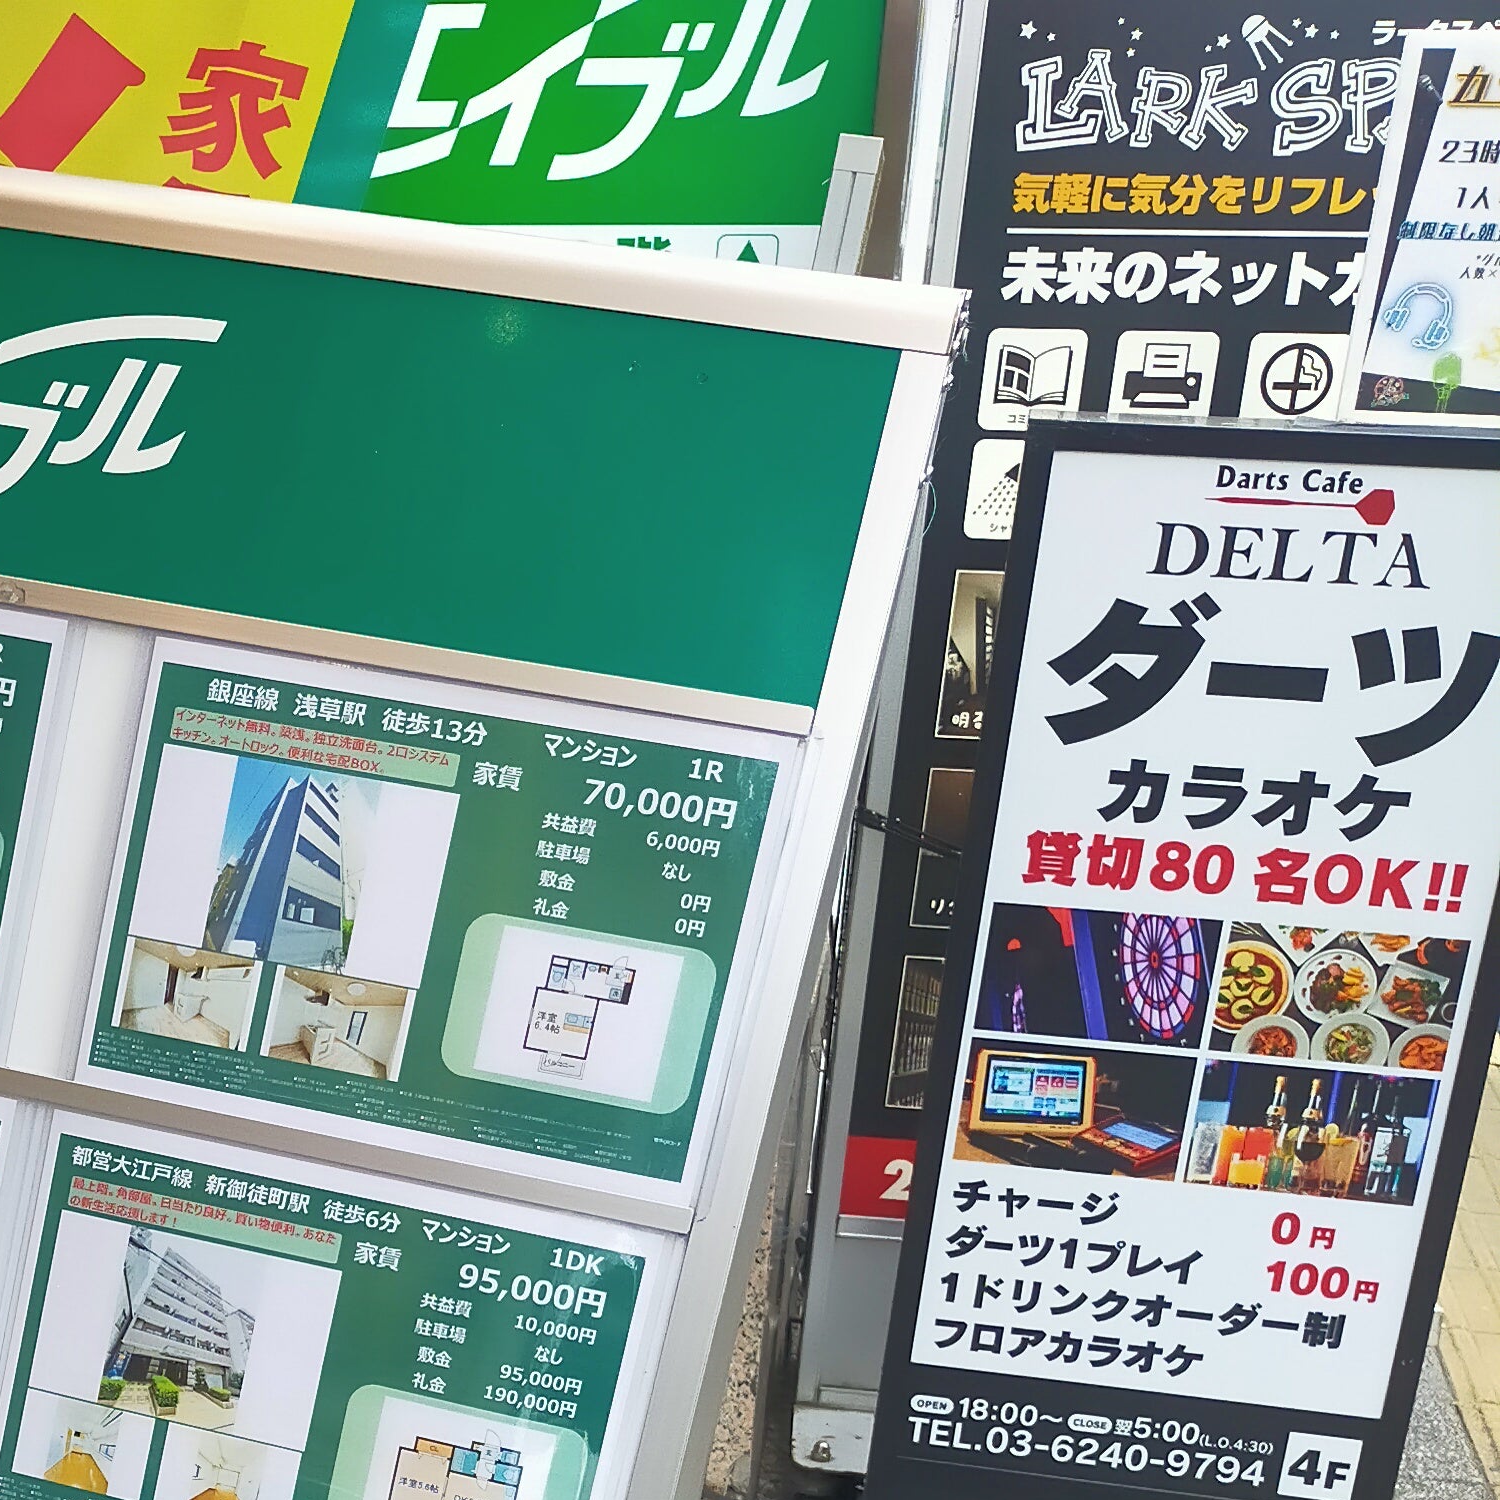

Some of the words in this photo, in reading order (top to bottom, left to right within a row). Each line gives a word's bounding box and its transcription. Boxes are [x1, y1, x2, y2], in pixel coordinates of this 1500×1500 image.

[159, 41, 309, 197] 家
[1016, 48, 1257, 152] LARK
[1272, 57, 1402, 157] SP
[1012, 172, 1378, 216] 気軽に気分をリフレ
[1457, 187, 1500, 209] 1人
[1398, 222, 1500, 240] 制限なし朝
[1215, 465, 1289, 491] Darts
[1302, 467, 1363, 495] Cafe
[989, 523, 1013, 534] シャ
[1146, 521, 1430, 590] DELTA
[1044, 591, 1500, 768] ダーツ
[205, 677, 280, 712] 銀座線
[291, 691, 368, 727] 浅草駅
[380, 706, 488, 746] 徒歩13分
[543, 732, 638, 768] マンション
[687, 757, 724, 783] 1R
[471, 760, 524, 792] 家賃
[582, 777, 738, 830] 70,000円
[1097, 758, 1412, 842] カラオケ
[534, 839, 591, 865] 駐車場
[660, 860, 692, 882] なし
[540, 811, 597, 837] 共益費
[645, 830, 721, 858] 6,000円
[531, 896, 570, 920] 礼金
[673, 917, 706, 938] 0円
[537, 868, 576, 892] 敷金
[679, 892, 712, 913] 0円
[70, 1144, 193, 1189] 都営大江戸線
[203, 1173, 311, 1214] 新御徒町駅
[321, 1198, 401, 1233] 徒歩6分
[421, 1217, 511, 1254] マンション
[548, 1246, 605, 1276] 1DK
[952, 1178, 1120, 1226] チャージ
[352, 1240, 402, 1272] 家賃
[457, 1262, 608, 1318] 95,000円
[945, 1225, 1203, 1285] ダーツ1プレイ
[1266, 1261, 1380, 1304] 100円
[418, 1291, 472, 1318] 共益費
[513, 1313, 597, 1345] 10,000円
[941, 1272, 1346, 1349] 1ドリンクオーダー制
[415, 1345, 452, 1369] 敷金
[498, 1363, 583, 1396] 95,000円
[934, 1317, 1203, 1377] フロアカラオケ
[410, 1371, 447, 1395] 礼金
[482, 1384, 578, 1419] 190,000円
[907, 1416, 1266, 1487] TEL.03-6240-9794
[916, 1397, 948, 1412] OPEN
[1073, 1416, 1108, 1431] CLOSE
[1288, 1450, 1352, 1491] 4F
